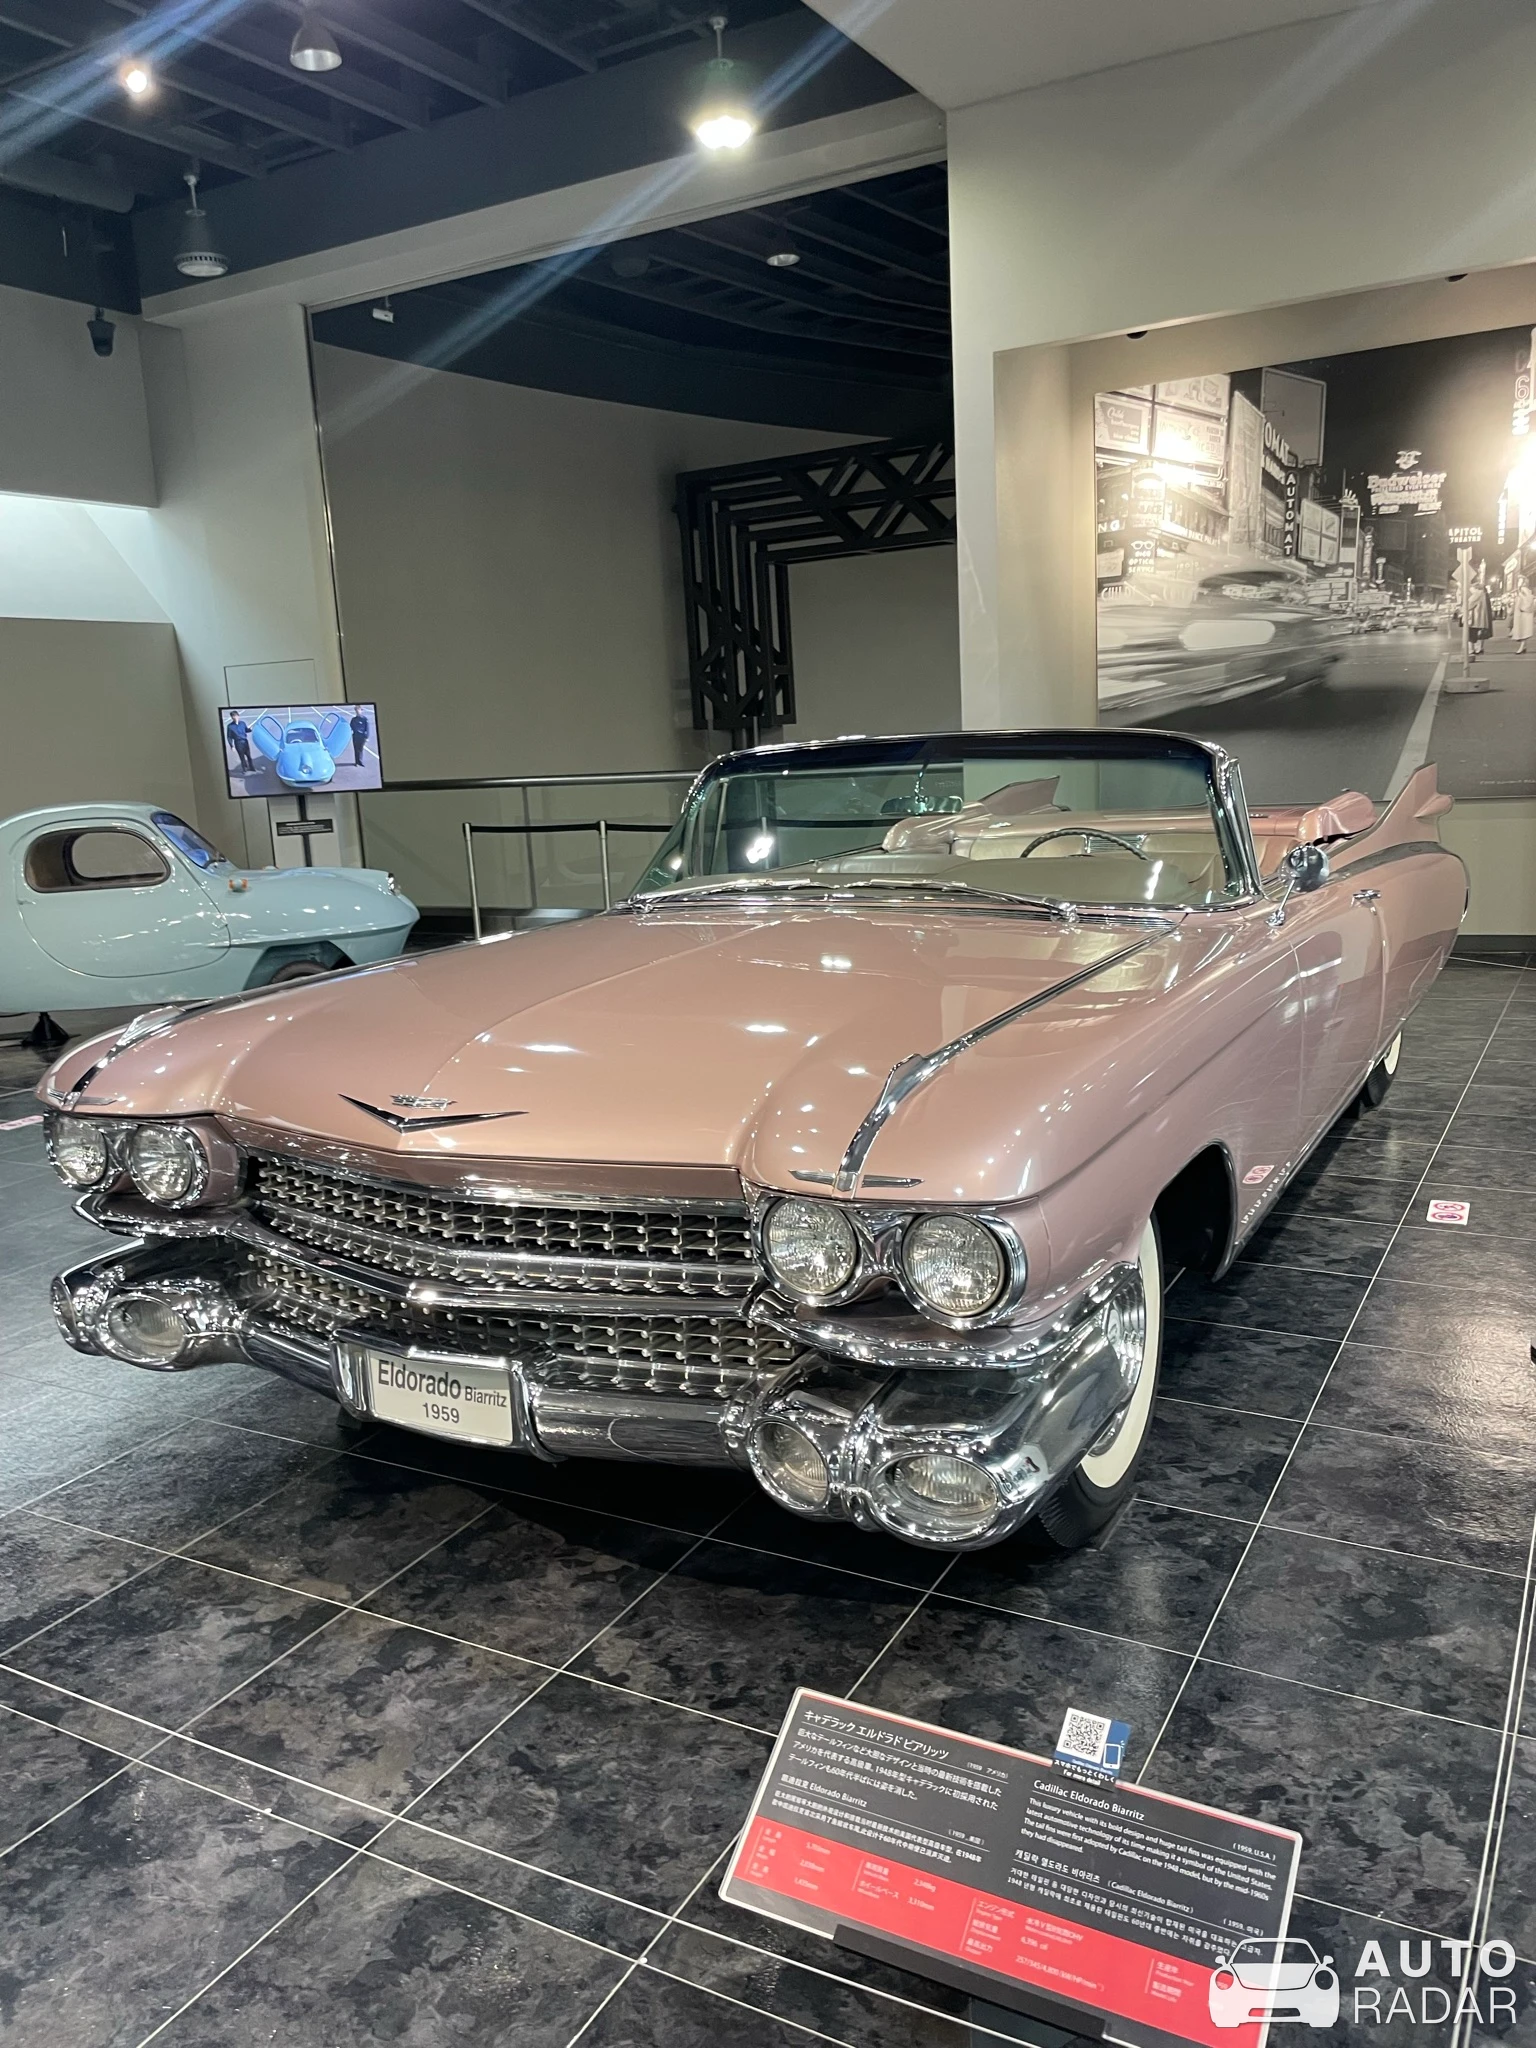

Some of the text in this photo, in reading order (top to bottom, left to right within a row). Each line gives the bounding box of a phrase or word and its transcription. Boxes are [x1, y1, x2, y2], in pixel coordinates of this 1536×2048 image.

[1367, 471, 1447, 489] Budweiser
[1284, 473, 1296, 555] AUTOMAT
[378, 1359, 508, 1408] Eldorado Biarritz
[422, 1402, 460, 1424] 1959
[804, 1710, 855, 1732] キャデラック
[855, 1726, 903, 1745] エルドラド
[1054, 1760, 1115, 1783] スマホでもっとくわしく
[809, 1782, 840, 1798] Eldorado
[841, 1792, 867, 1807] Biarritz
[1034, 1780, 1068, 1797] Cadillac
[1070, 1790, 1109, 1809] Eldorado
[1112, 1803, 1144, 1820] Biarritz
[1021, 1828, 1034, 1838] they
[1034, 1832, 1046, 1840] had
[1026, 1807, 1043, 1818] latest
[1043, 1814, 1078, 1829] automotive
[1078, 1825, 1113, 1841] technology
[1146, 1846, 1170, 1859] making
[1182, 1858, 1206, 1869] symbol
[1214, 1867, 1226, 1875] the
[1227, 1870, 1250, 1883] United
[1029, 1797, 1041, 1806] This
[1062, 1809, 1083, 1820] vehicle
[1084, 1816, 1098, 1824] with
[1108, 1822, 1123, 1832] bold
[1123, 1828, 1144, 1839] design
[1145, 1835, 1158, 1843] and
[1159, 1838, 1175, 1849] huge
[1176, 1844, 1187, 1852] tail
[1188, 1847, 1200, 1856] fins
[1214, 1857, 1247, 1871] equipped
[1248, 1867, 1263, 1876] with
[1264, 1871, 1276, 1880] the
[1024, 1817, 1035, 1826] The
[1056, 1829, 1071, 1837] were
[1083, 1838, 1109, 1850] adopted
[1109, 1844, 1118, 1853] by
[1118, 1847, 1142, 1860] Cadillac
[1152, 1859, 1162, 1867] the
[1164, 1862, 1179, 1872] 1948
[1202, 1874, 1213, 1883] but
[1214, 1878, 1222, 1887] by
[1223, 1881, 1234, 1889] the
[1137, 1890, 1165, 1904] Eldorado
